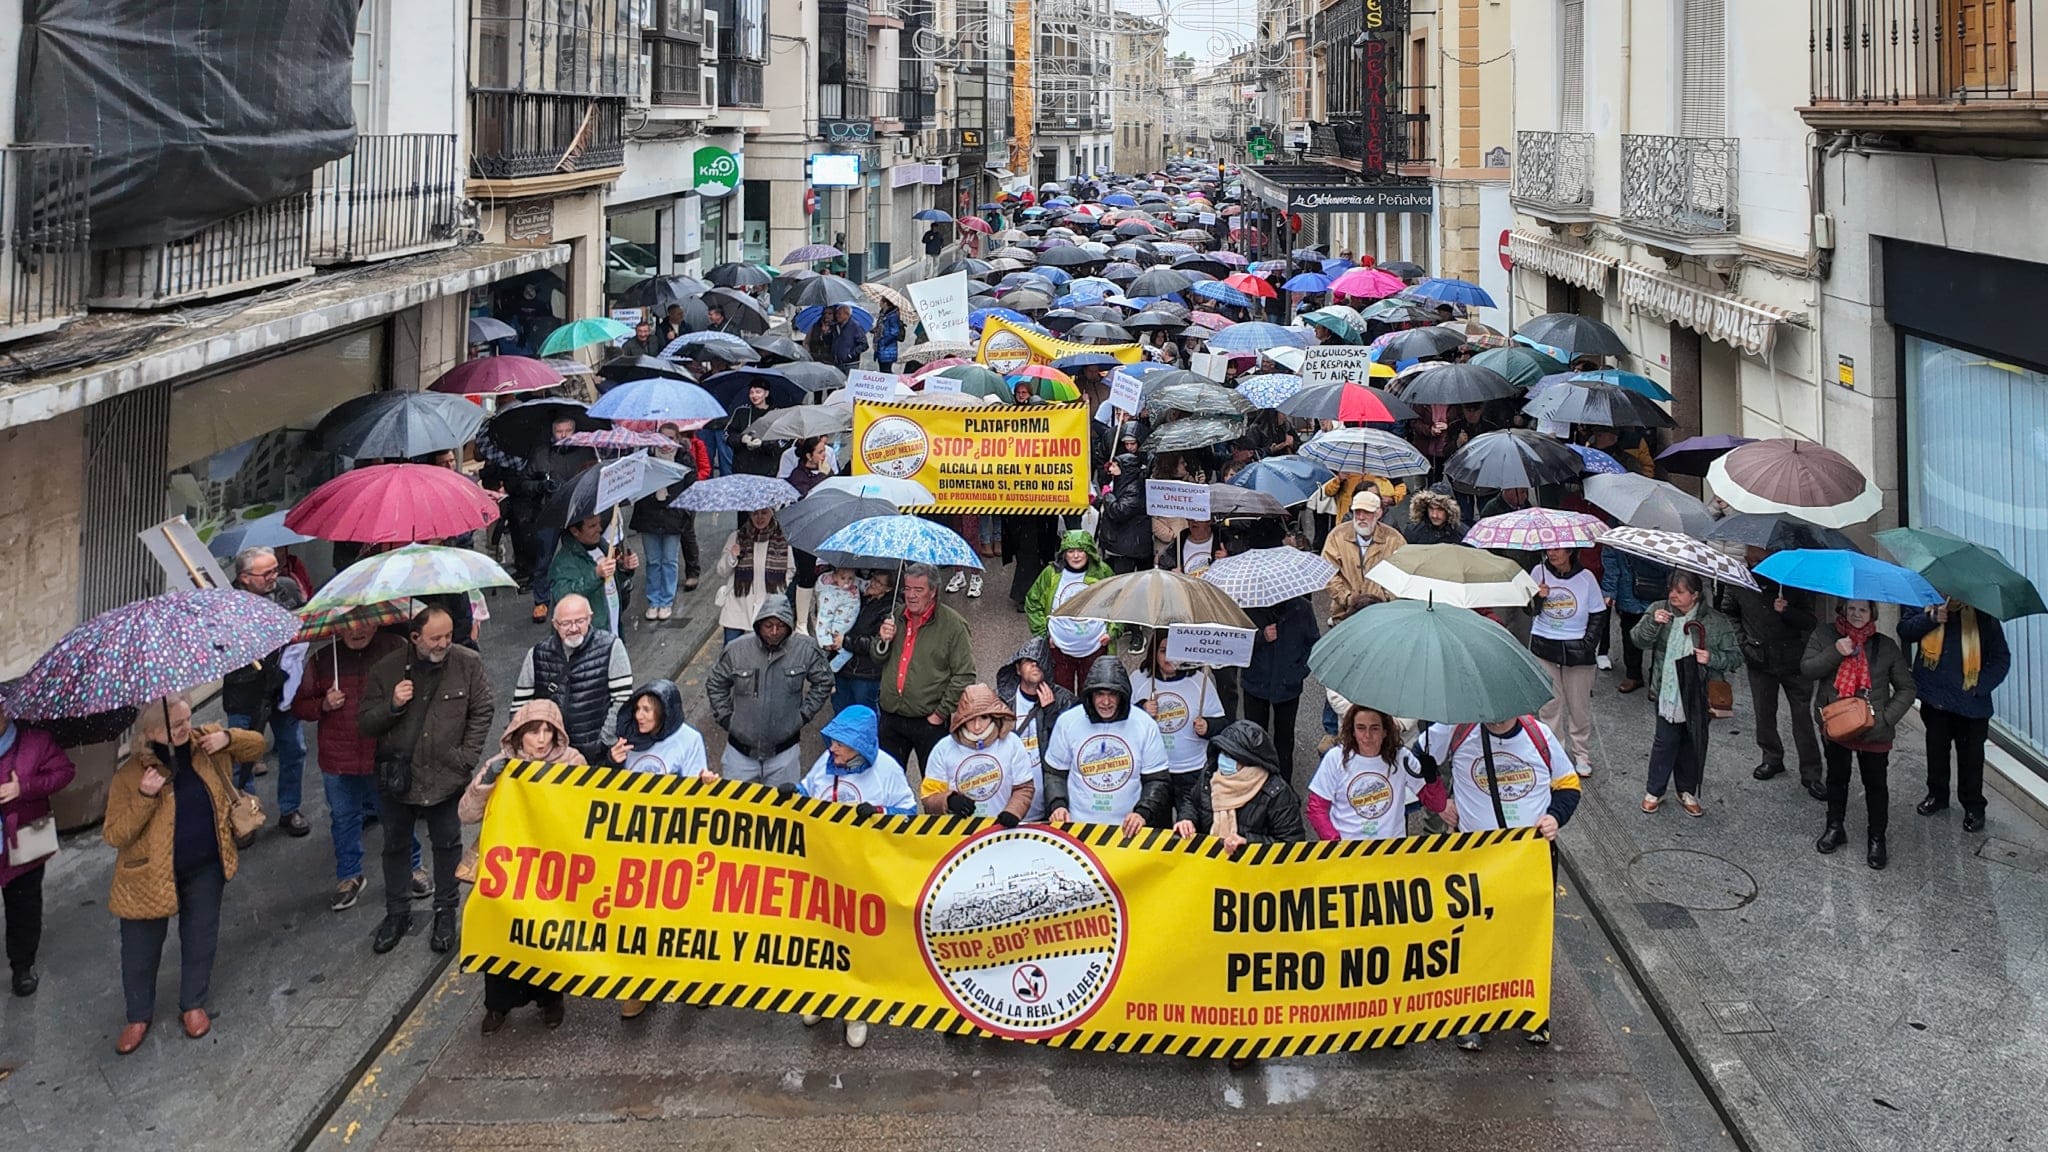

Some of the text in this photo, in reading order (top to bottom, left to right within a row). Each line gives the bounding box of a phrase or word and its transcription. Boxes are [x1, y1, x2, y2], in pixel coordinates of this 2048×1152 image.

[1363, 194, 1375, 204] de
[1379, 193, 1432, 205] Peñalver
[1695, 300, 1713, 325] EN
[1306, 360, 1362, 370] DE RESPIRAR
[1312, 371, 1327, 381] TU
[965, 418, 1049, 433] PLATAFORMA
[932, 437, 973, 457] STOP
[940, 463, 1073, 475] ALCALA LA REAL Y ALDEAS
[939, 477, 1073, 491] BIOMETANO SI, PERO NO ASÍ
[938, 492, 948, 500] DE
[950, 492, 997, 501] PROXIMIDAD
[1006, 493, 1070, 503] AUTOSUFICIENCIA
[1164, 493, 1193, 503] ÚNETE
[1177, 628, 1247, 639] SALUD ANTES
[1184, 647, 1234, 655] NEGOCIO
[584, 800, 806, 857] PLATAFORMA
[479, 846, 596, 902] STOP
[1213, 872, 1495, 933] BIOMETANO SI,
[509, 918, 851, 971] ALCALA LA REAL Y ALDEAS
[937, 940, 983, 960] STOP
[1034, 915, 1111, 948] METANO
[1227, 925, 1465, 993] PERO NO ASÍ
[961, 961, 1101, 1018] ALCALÁ LA REAL Y ALDEAS
[1125, 978, 1536, 1026] POR UN MODELO DE PROXIMIDAD Y AUTOSUFICIENCIA
